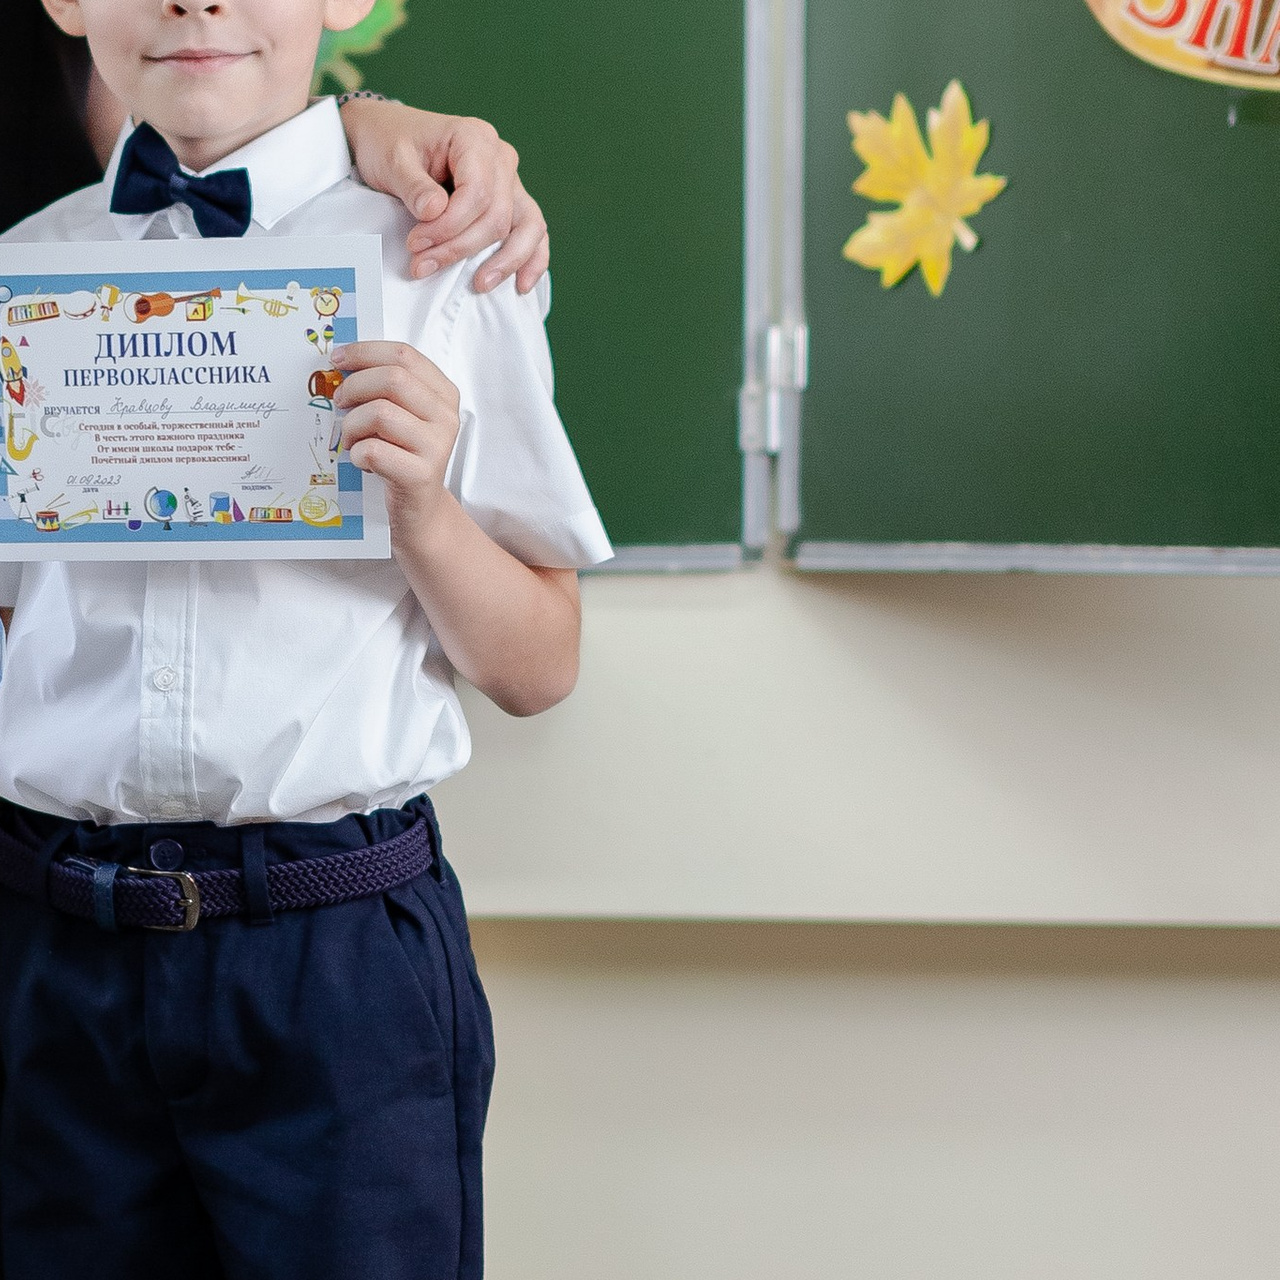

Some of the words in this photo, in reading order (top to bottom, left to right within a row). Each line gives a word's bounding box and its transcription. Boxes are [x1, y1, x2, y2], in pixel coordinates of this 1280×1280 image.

[94, 330, 239, 365] ДИПЛОМ
[63, 365, 272, 388] ПЕРВОКЛАССНИКА
[43, 405, 101, 417] ВРУЧАЕТСЯ
[189, 395, 279, 420] Владимиру
[78, 422, 115, 432] Сегодня
[117, 423, 122, 431] в
[123, 421, 160, 431] особый,
[161, 419, 234, 432] торжественный
[235, 419, 261, 430] день!
[94, 433, 101, 442] В
[102, 434, 128, 442] честь
[129, 434, 156, 442] этого
[156, 433, 196, 442] важного
[197, 432, 246, 443] праздника
[96, 444, 111, 454] От
[142, 445, 174, 453] школы
[176, 444, 214, 454] подарок
[215, 442, 237, 453] тебе
[90, 455, 138, 465] Почётный
[139, 456, 174, 465] диплом
[175, 453, 251, 465] первоклассника!
[81, 486, 100, 494] дата
